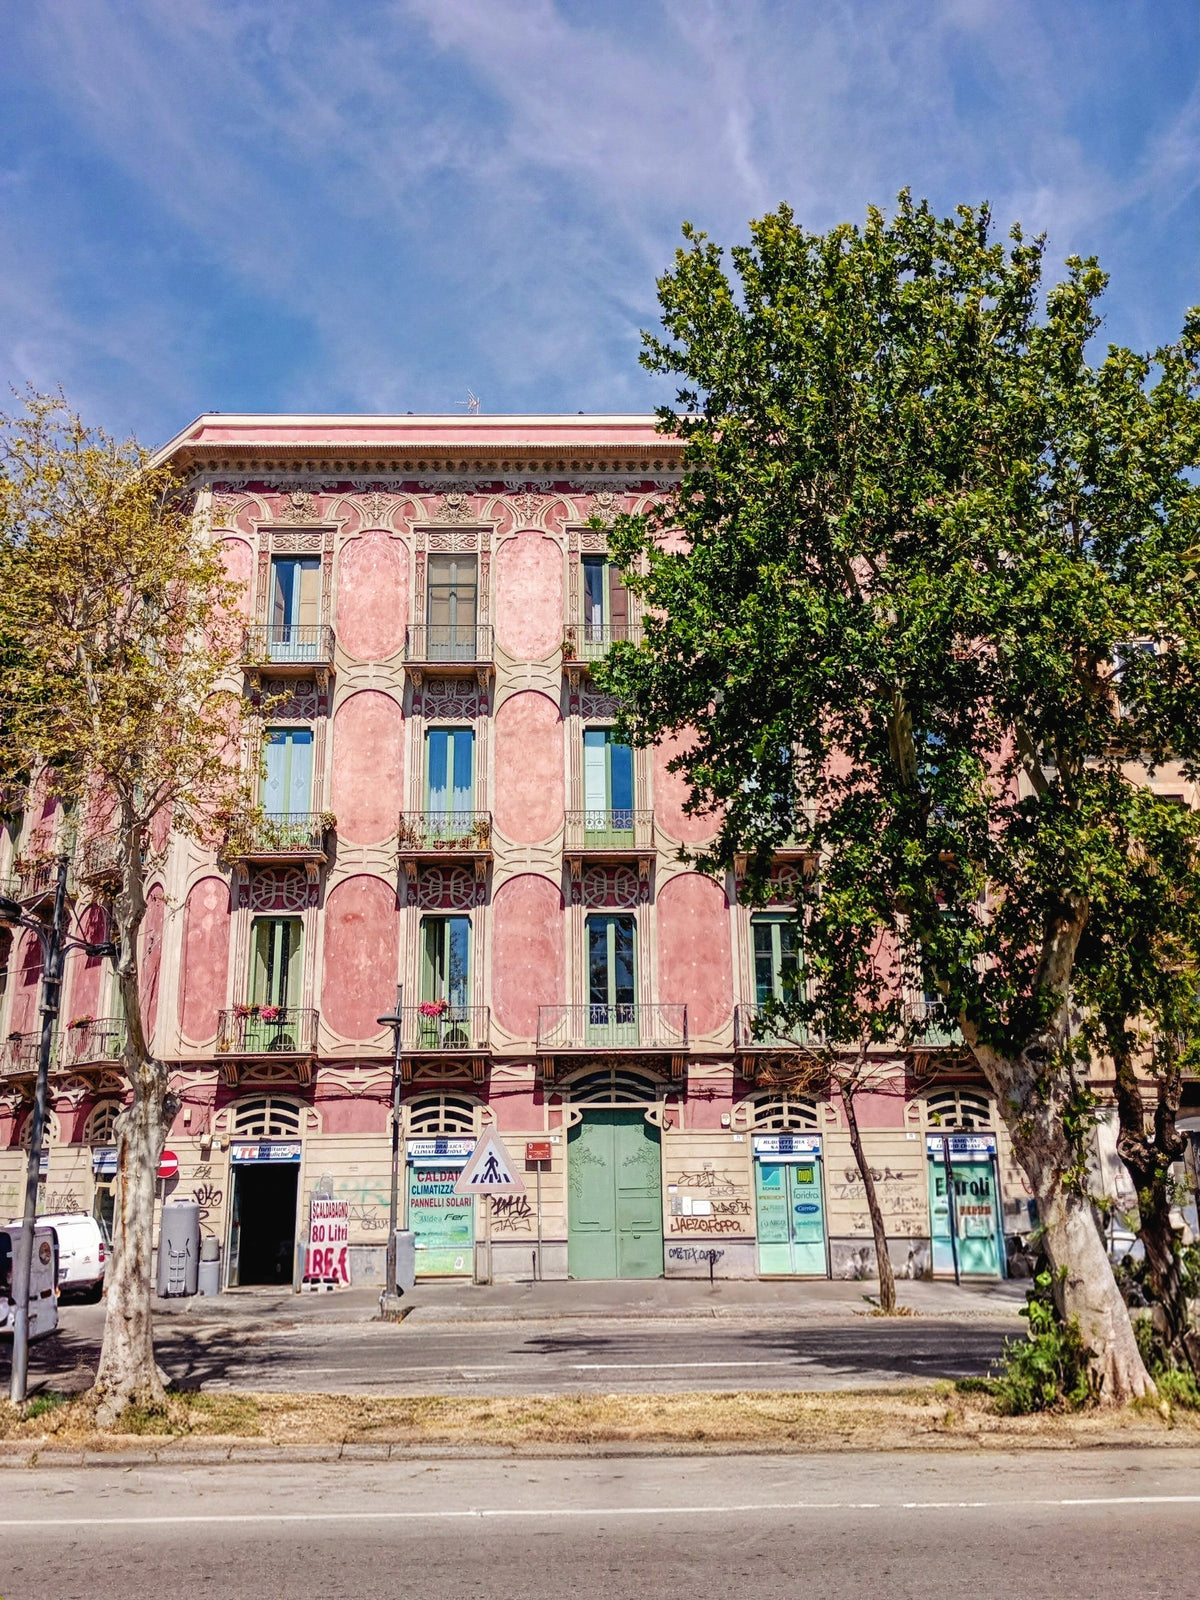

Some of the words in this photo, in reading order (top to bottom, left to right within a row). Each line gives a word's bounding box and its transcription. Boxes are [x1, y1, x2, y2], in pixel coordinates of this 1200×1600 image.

[240, 1147, 258, 1158] TC
[417, 1170, 462, 1182] CALDAI
[410, 1198, 445, 1208] PANNELLI
[446, 1197, 472, 1207] SOLARI
[312, 1224, 325, 1243] 80
[328, 1223, 348, 1242] Litri
